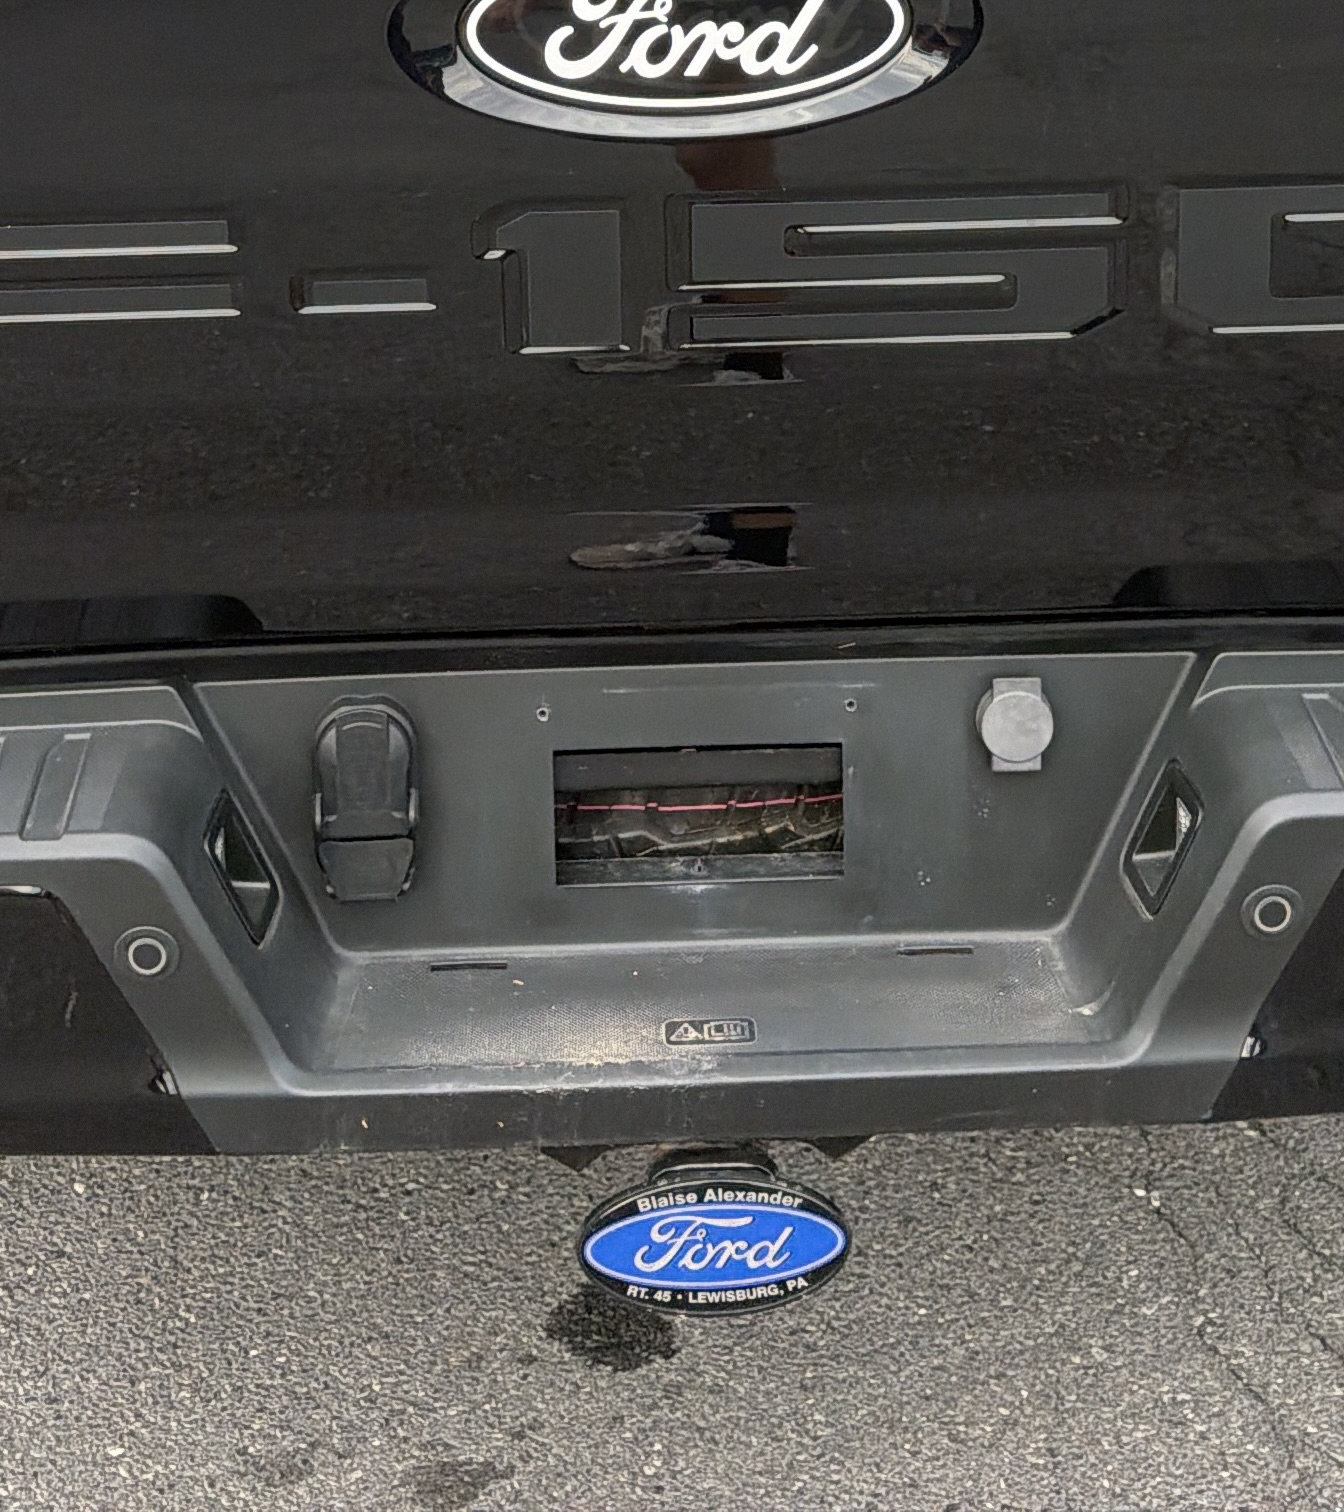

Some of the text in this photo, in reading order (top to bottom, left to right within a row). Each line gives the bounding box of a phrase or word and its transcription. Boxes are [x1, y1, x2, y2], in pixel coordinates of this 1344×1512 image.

[636, 1188, 804, 1213] Blaise Alexander
[633, 1215, 794, 1272] Ford
[626, 1276, 809, 1304] RT. 45 LEWISBURG, PA
